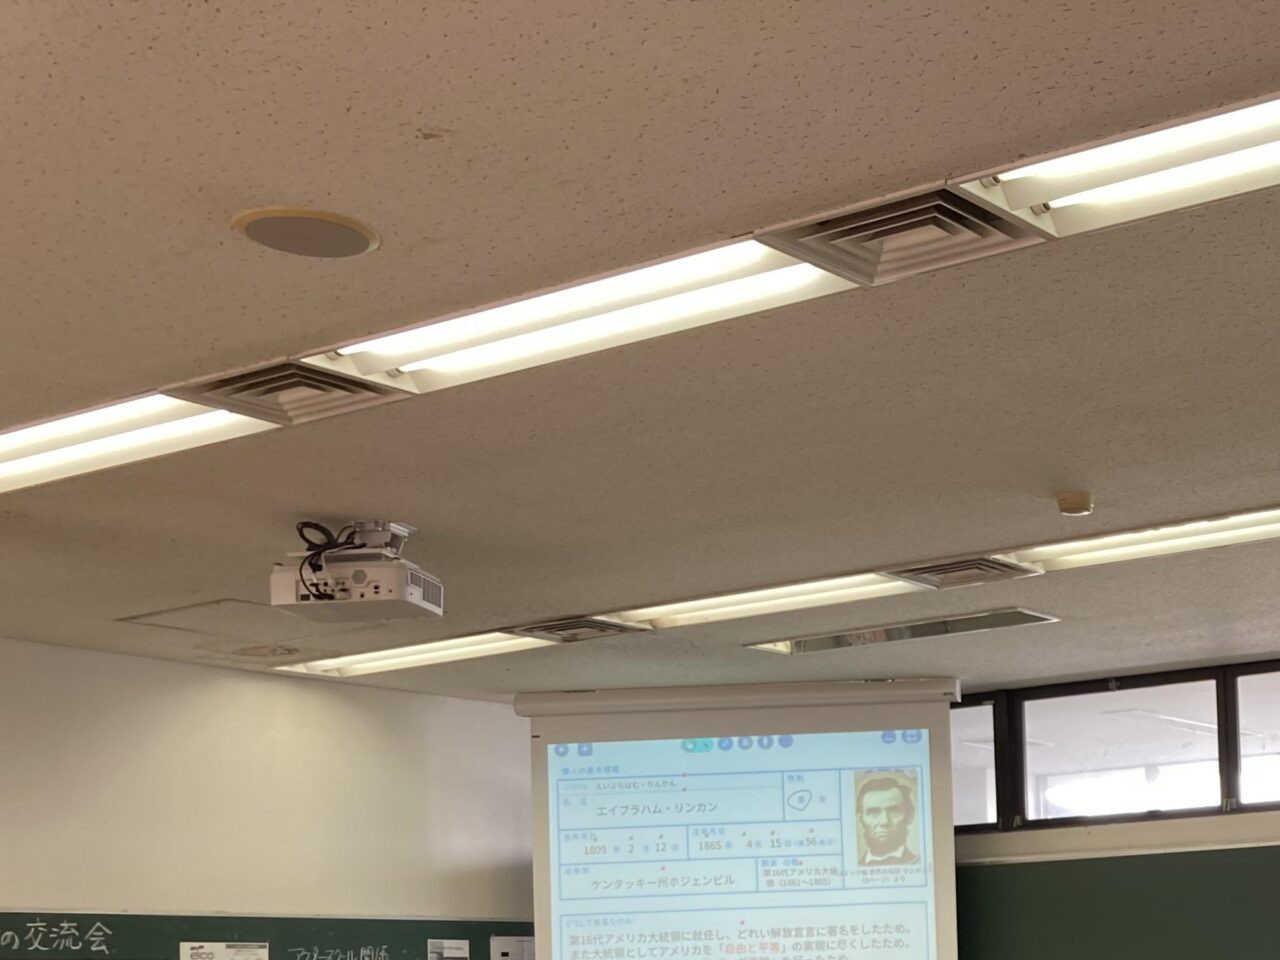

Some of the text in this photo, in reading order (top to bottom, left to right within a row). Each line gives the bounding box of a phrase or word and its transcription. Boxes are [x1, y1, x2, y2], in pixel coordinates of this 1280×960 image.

[596, 801, 719, 817] エイブラハム・リンカン
[591, 874, 735, 891] ケンタッキー州ホジェンビル
